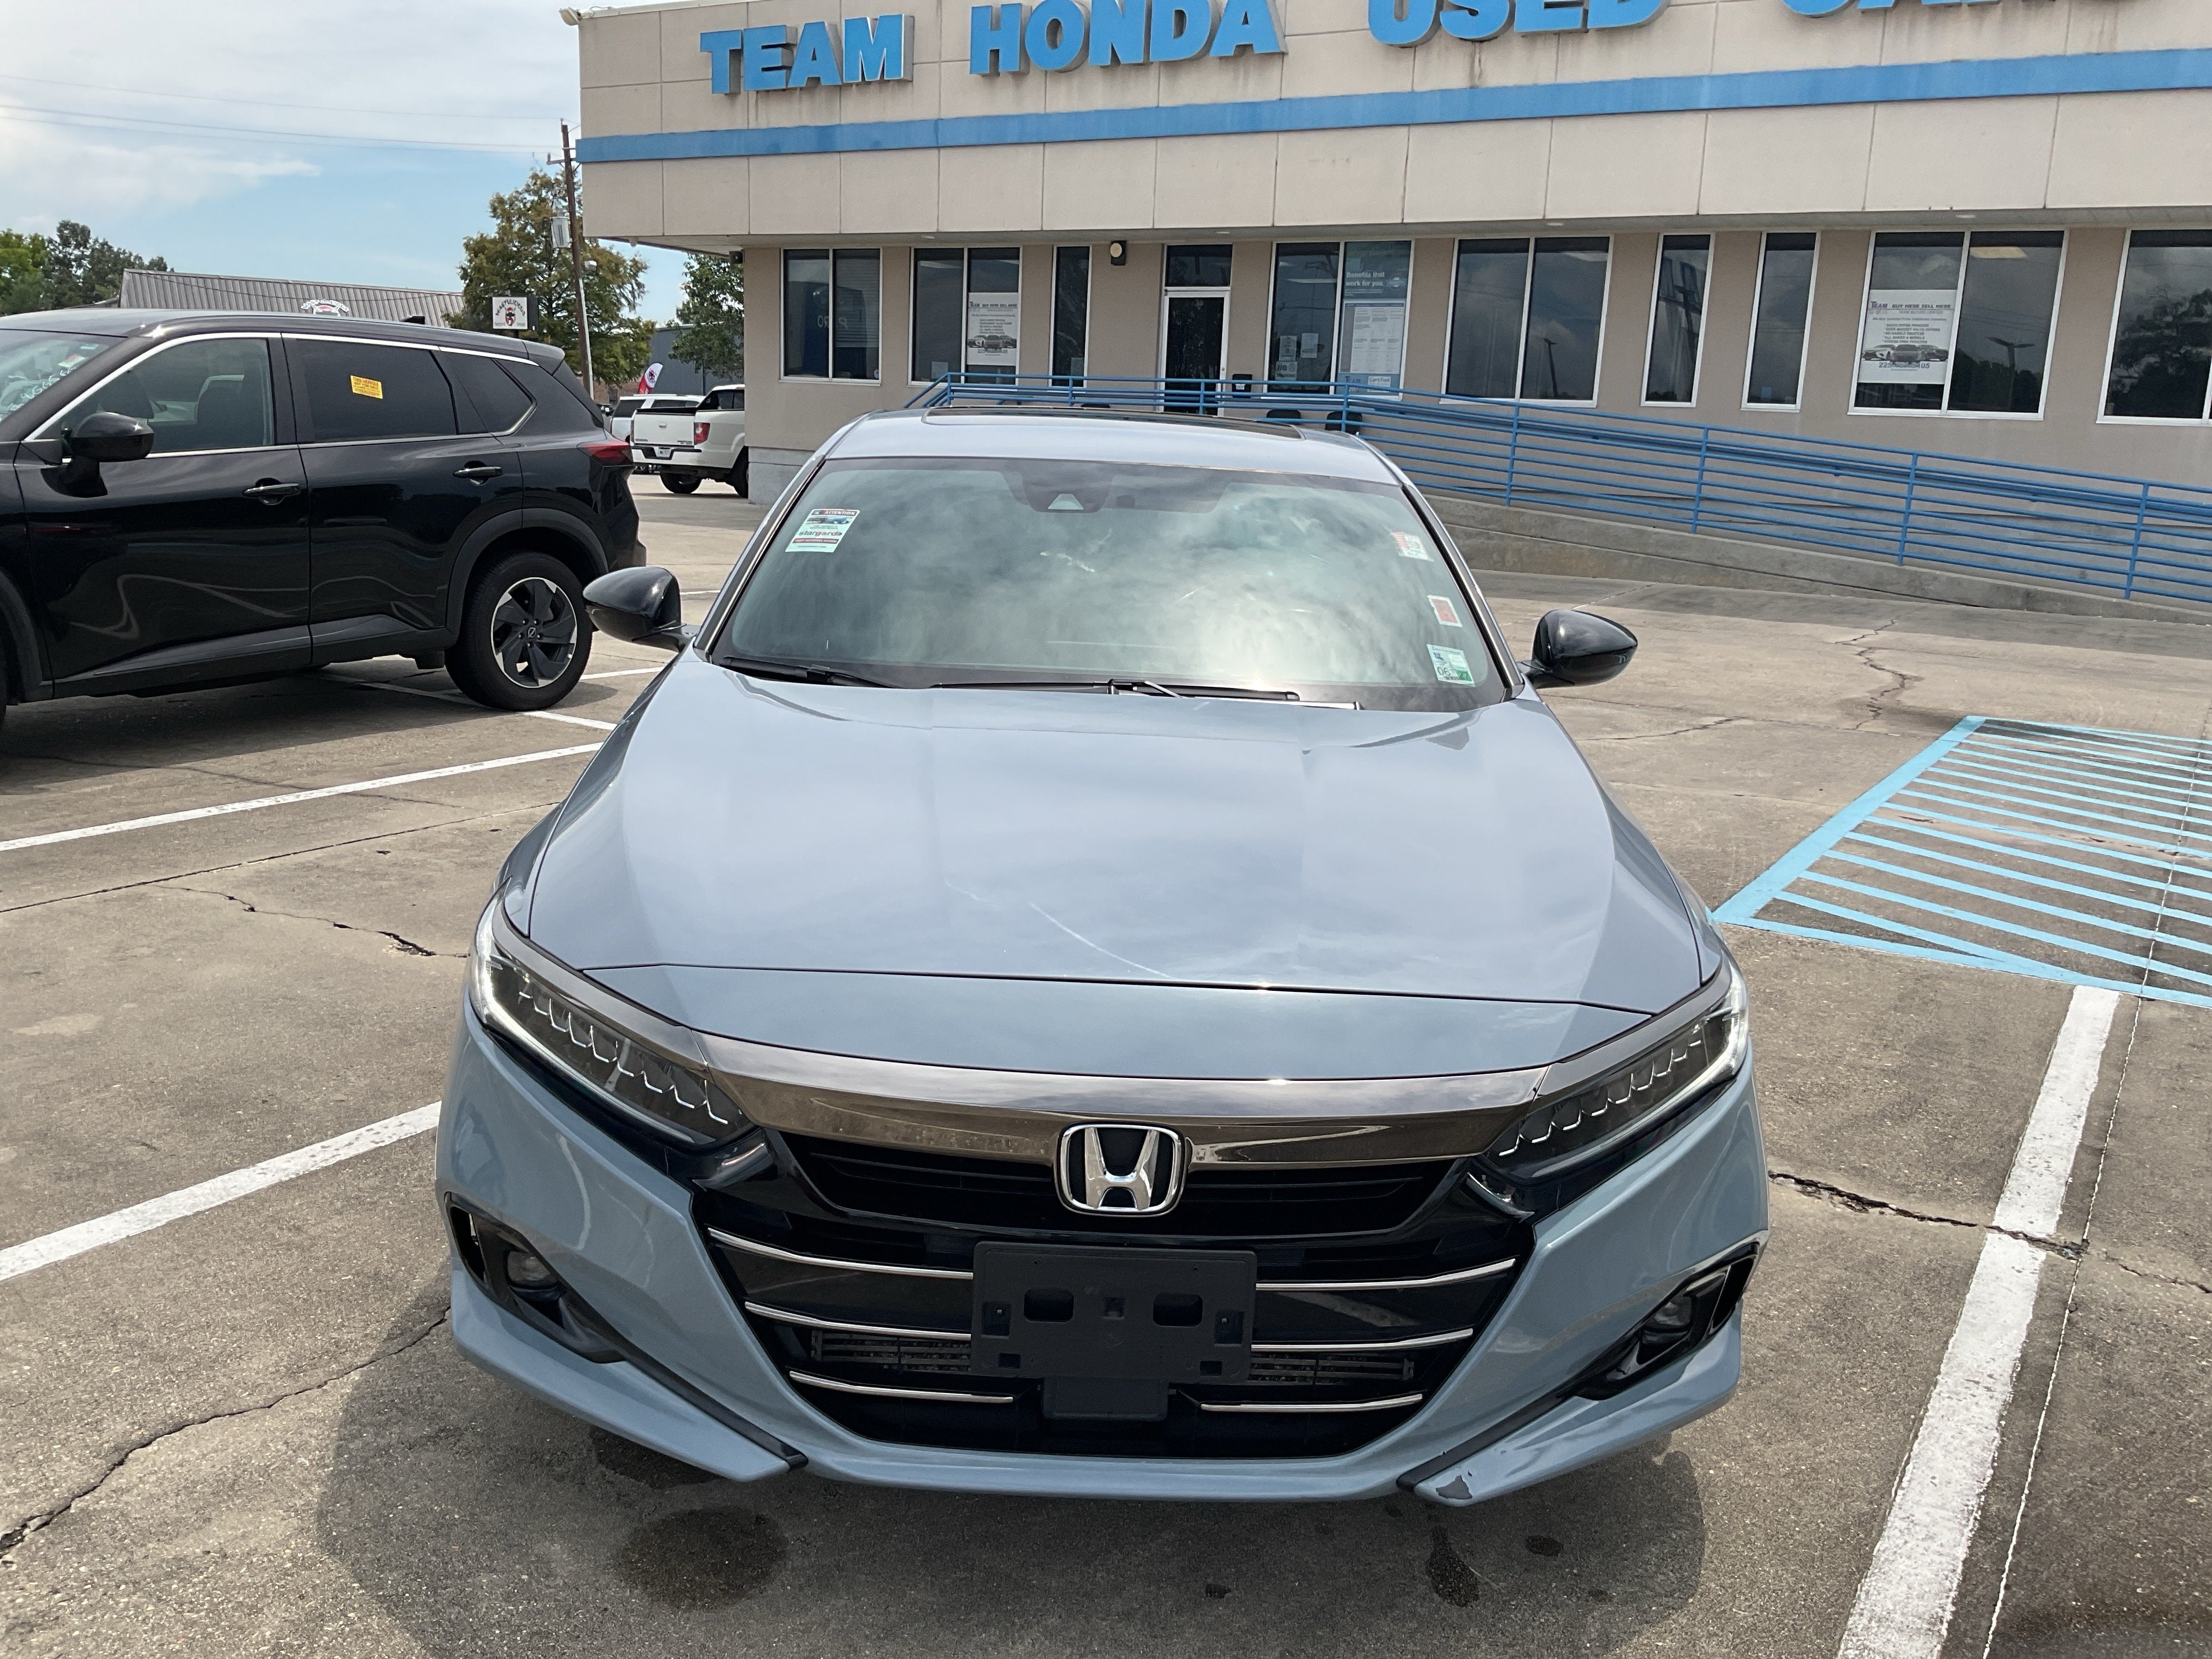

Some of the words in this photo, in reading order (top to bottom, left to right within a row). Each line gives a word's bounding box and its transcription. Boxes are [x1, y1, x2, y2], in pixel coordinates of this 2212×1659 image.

[701, 14, 913, 94] TEAM
[969, 0, 1286, 75] HONDA
[1437, 667, 1451, 676] 06
